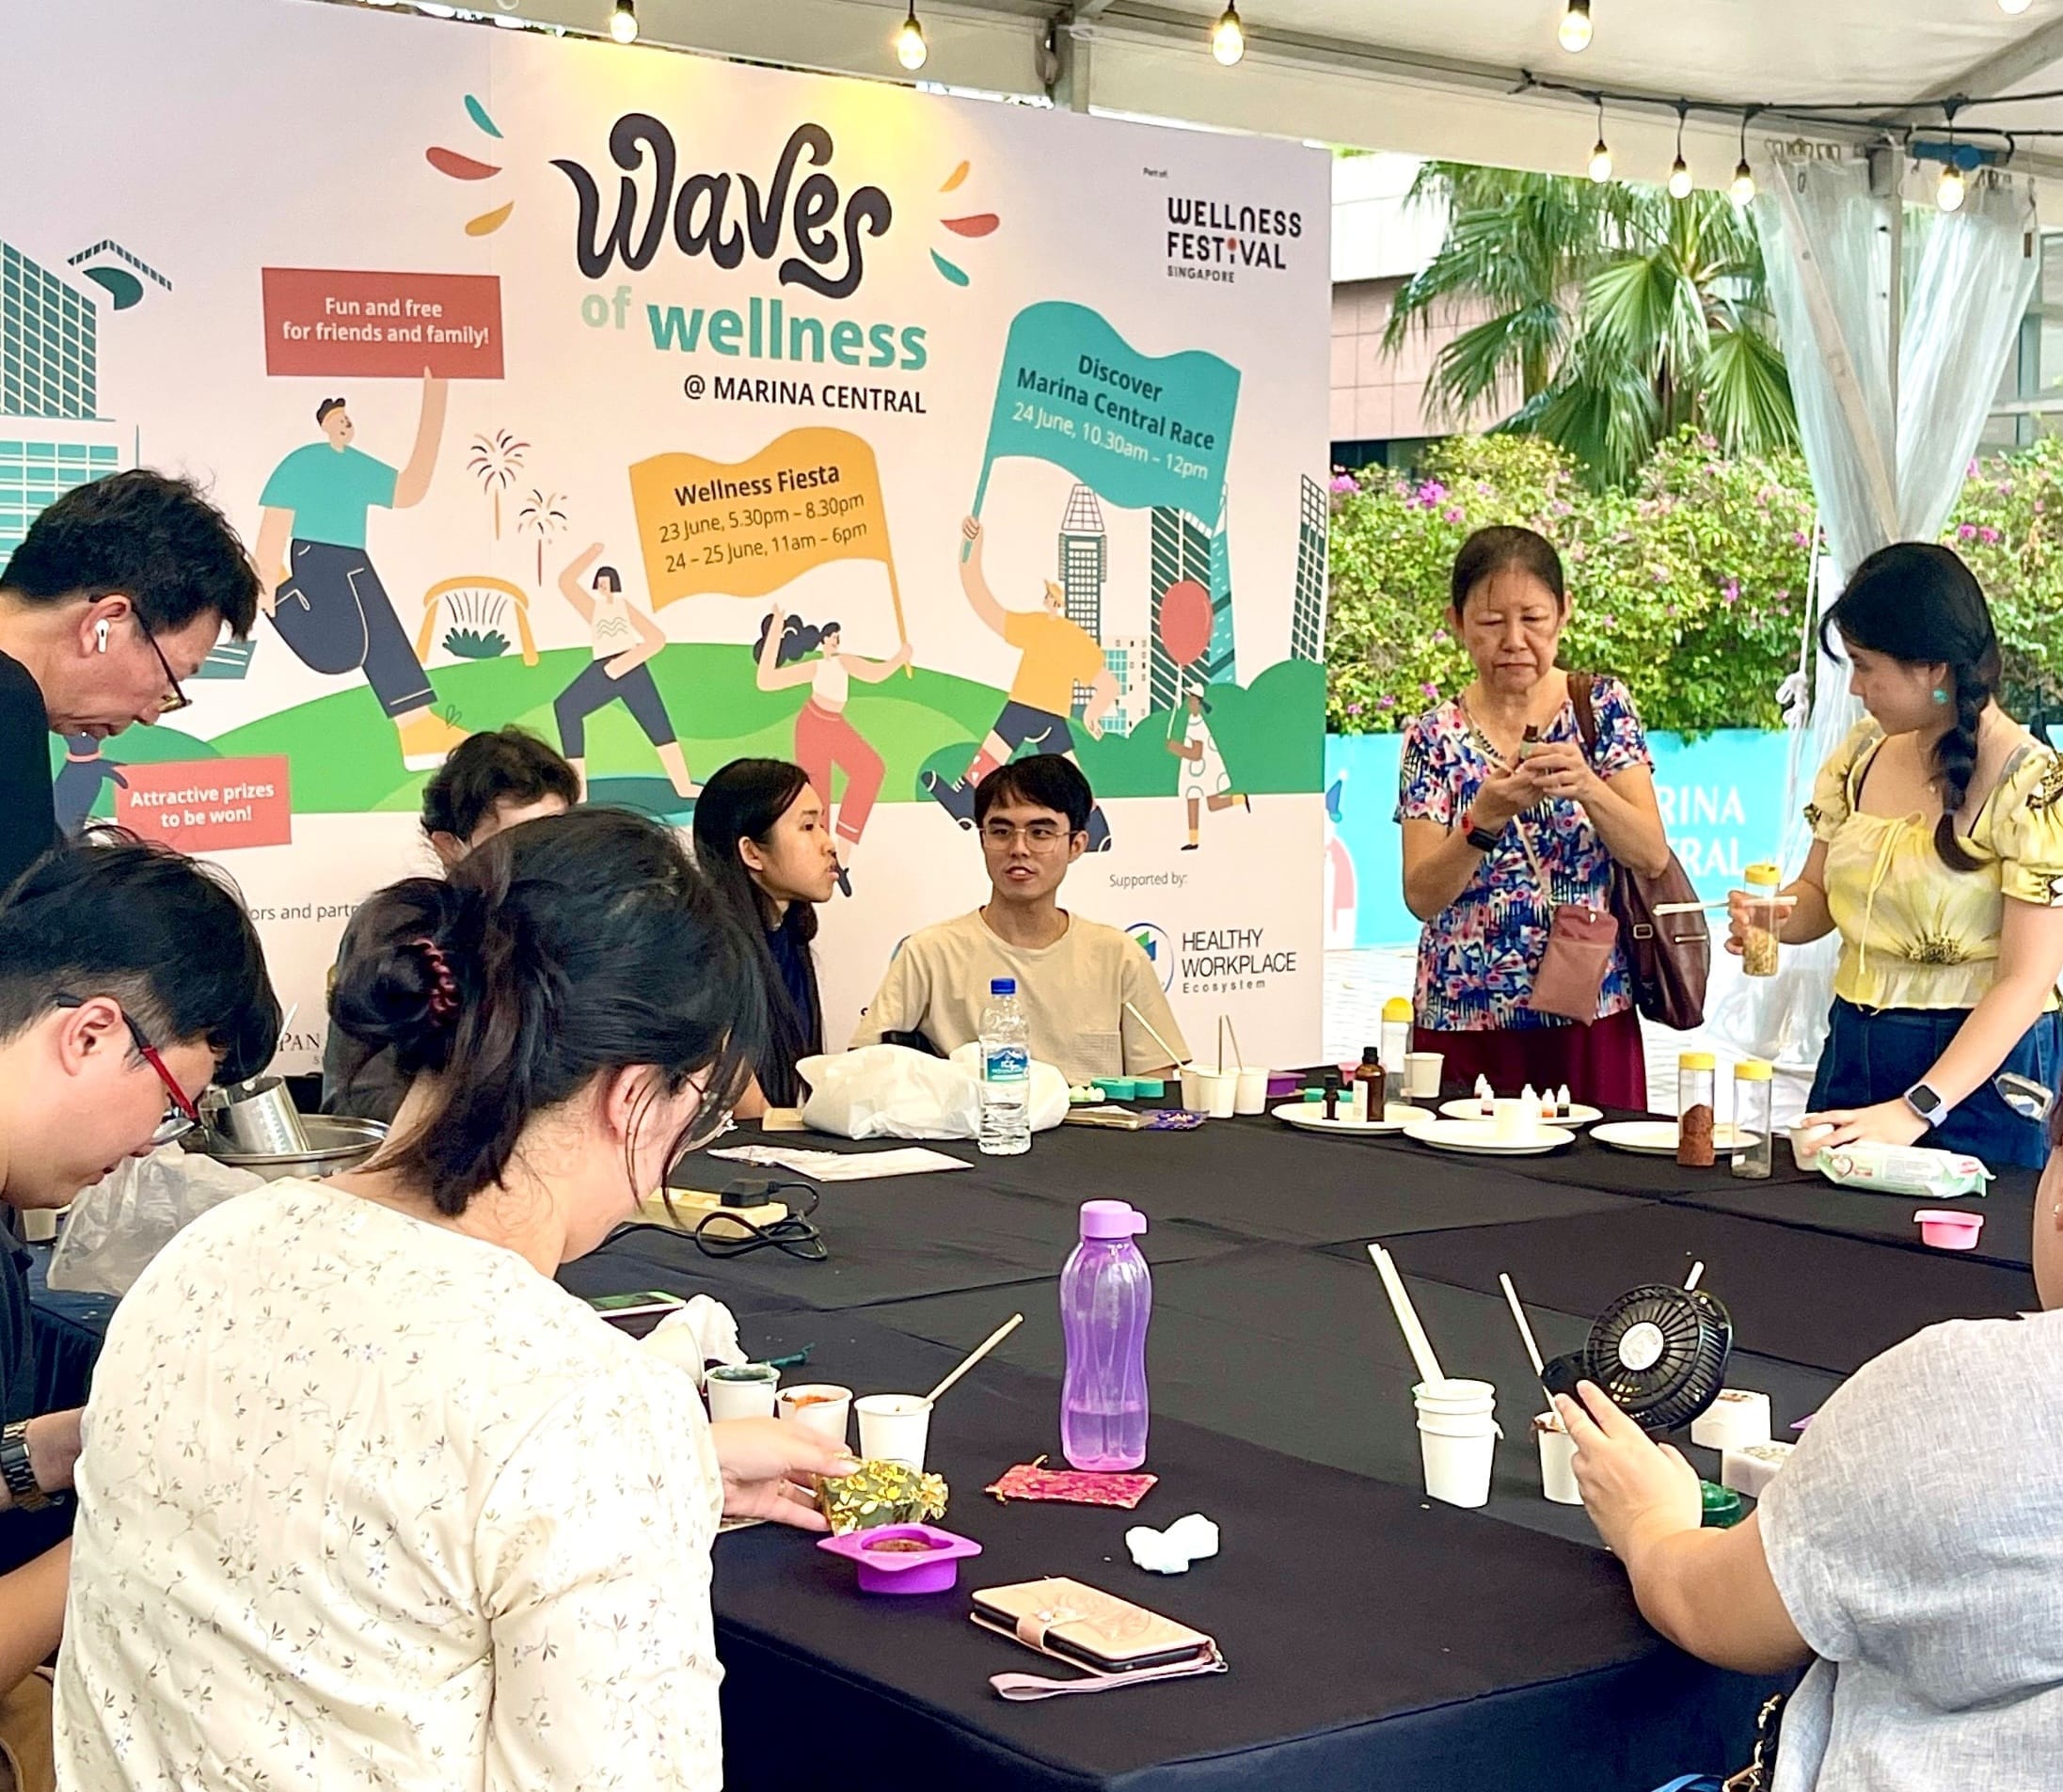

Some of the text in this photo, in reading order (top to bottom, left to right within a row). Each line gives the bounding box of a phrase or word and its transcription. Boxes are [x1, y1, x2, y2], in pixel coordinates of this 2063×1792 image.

[548, 113, 892, 298] Waves
[1167, 198, 1302, 238] WELLNESS
[1167, 231, 1287, 270] FESTIVAL
[1167, 265, 1235, 283] SINGAPORE
[325, 297, 442, 319] Fun and free
[283, 322, 489, 349] for friends and family!
[581, 286, 927, 371] of wellness
[684, 375, 927, 414] @ MARINA CENTRAL
[1078, 354, 1163, 403] Discover
[1017, 367, 1214, 451] Marina Central Race
[1011, 402, 1034, 422] 24
[1034, 407, 1076, 439] June,
[1083, 421, 1149, 464] 10.30am
[1166, 453, 1209, 482] 12pm
[674, 466, 840, 507] Wellness Fiesta
[659, 523, 681, 544] 23
[684, 515, 724, 542] June,
[728, 508, 790, 530] 5.30pm
[805, 493, 865, 520] 8.30pm
[665, 552, 687, 573] 24
[704, 544, 724, 565] 25
[727, 540, 769, 565] June,
[771, 533, 817, 553] 11am
[832, 521, 867, 547] 6pm
[131, 783, 275, 808] Attractive prizes
[161, 806, 252, 828] to be won!
[1109, 872, 1168, 889] Supported
[280, 903, 311, 920] and
[1182, 928, 1263, 952] HEALTHY
[1182, 952, 1297, 978] WORKPLACE
[1182, 979, 1266, 993] Ecosystem
[279, 1033, 320, 1052] PAN
